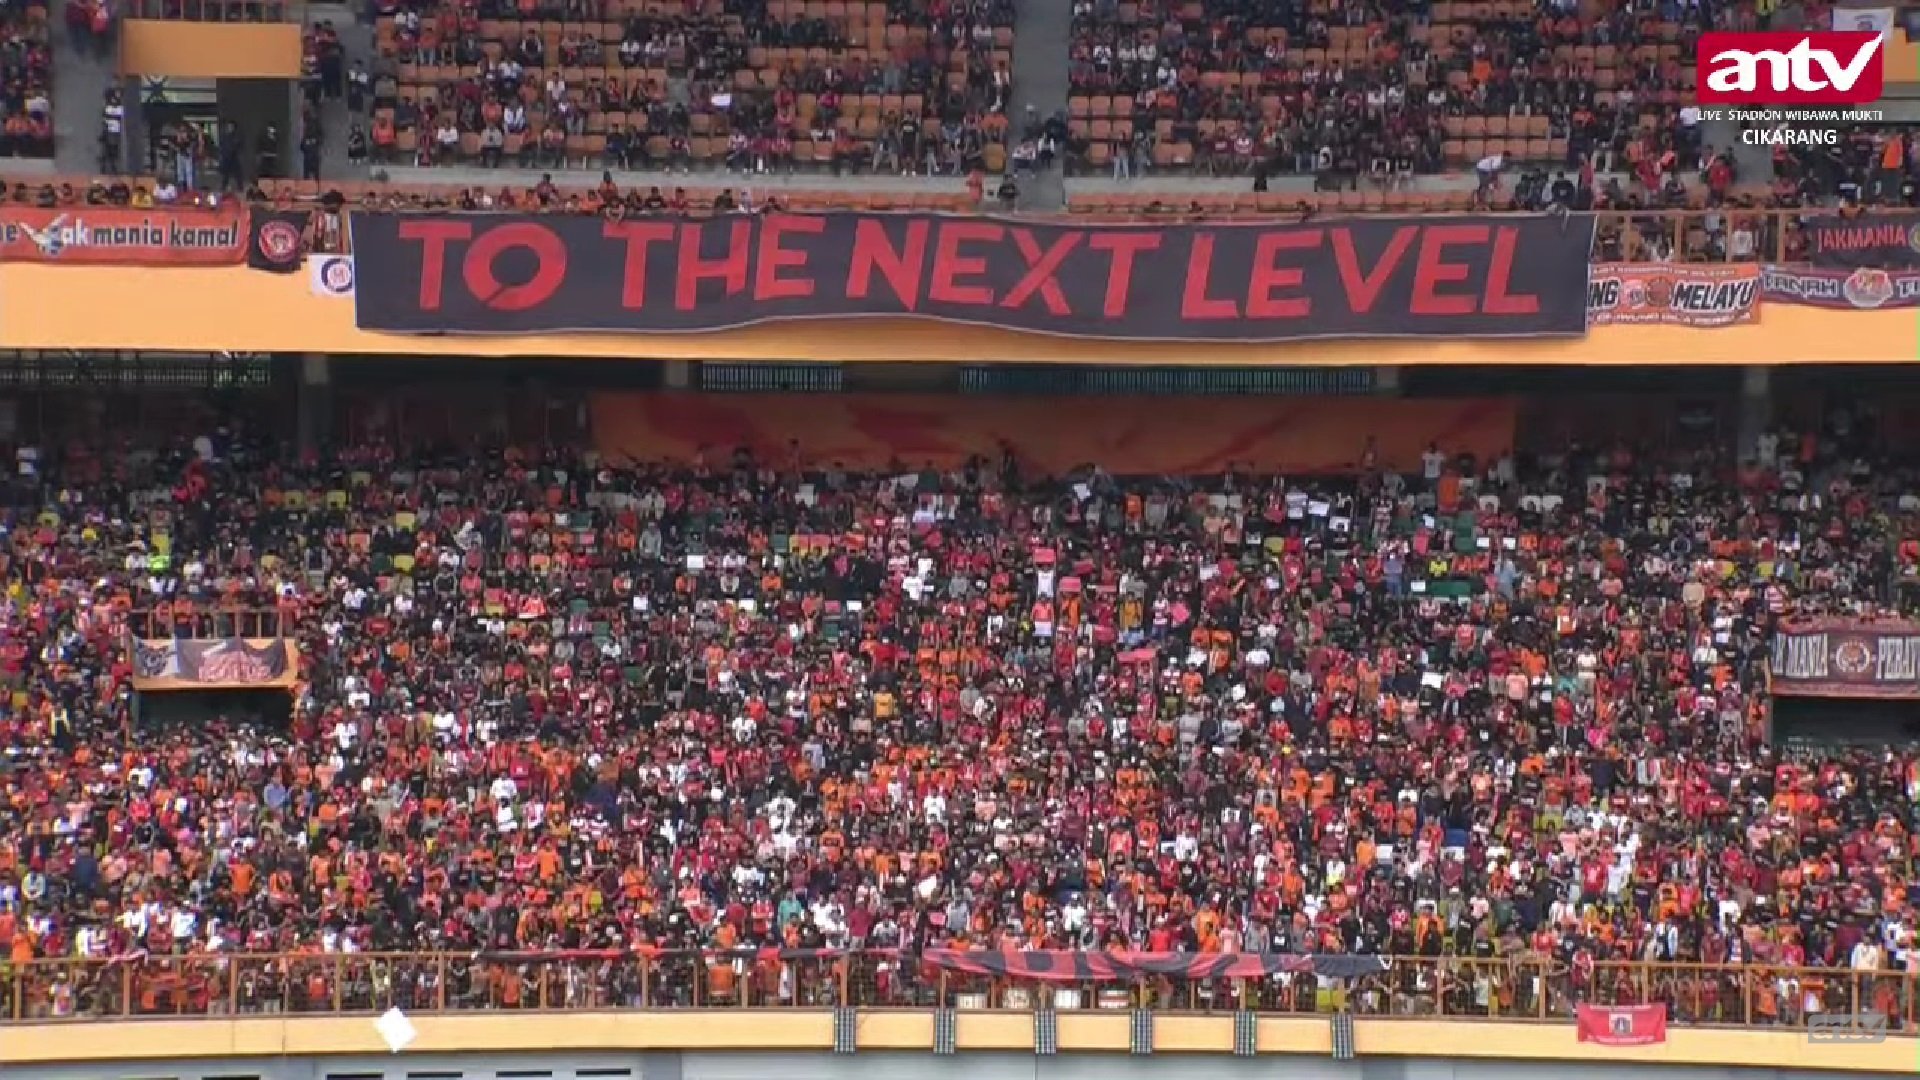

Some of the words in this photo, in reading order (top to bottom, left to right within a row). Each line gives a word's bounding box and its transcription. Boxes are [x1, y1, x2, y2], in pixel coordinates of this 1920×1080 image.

[93, 219, 164, 246] mania
[170, 220, 239, 247] kamal
[1817, 224, 1907, 253] JAKMANIA
[400, 221, 567, 311] TO
[604, 216, 825, 311] THE
[846, 219, 1161, 317] NEXT
[1181, 225, 1540, 320] LEVEL
[1671, 277, 1757, 313] MELAYU
